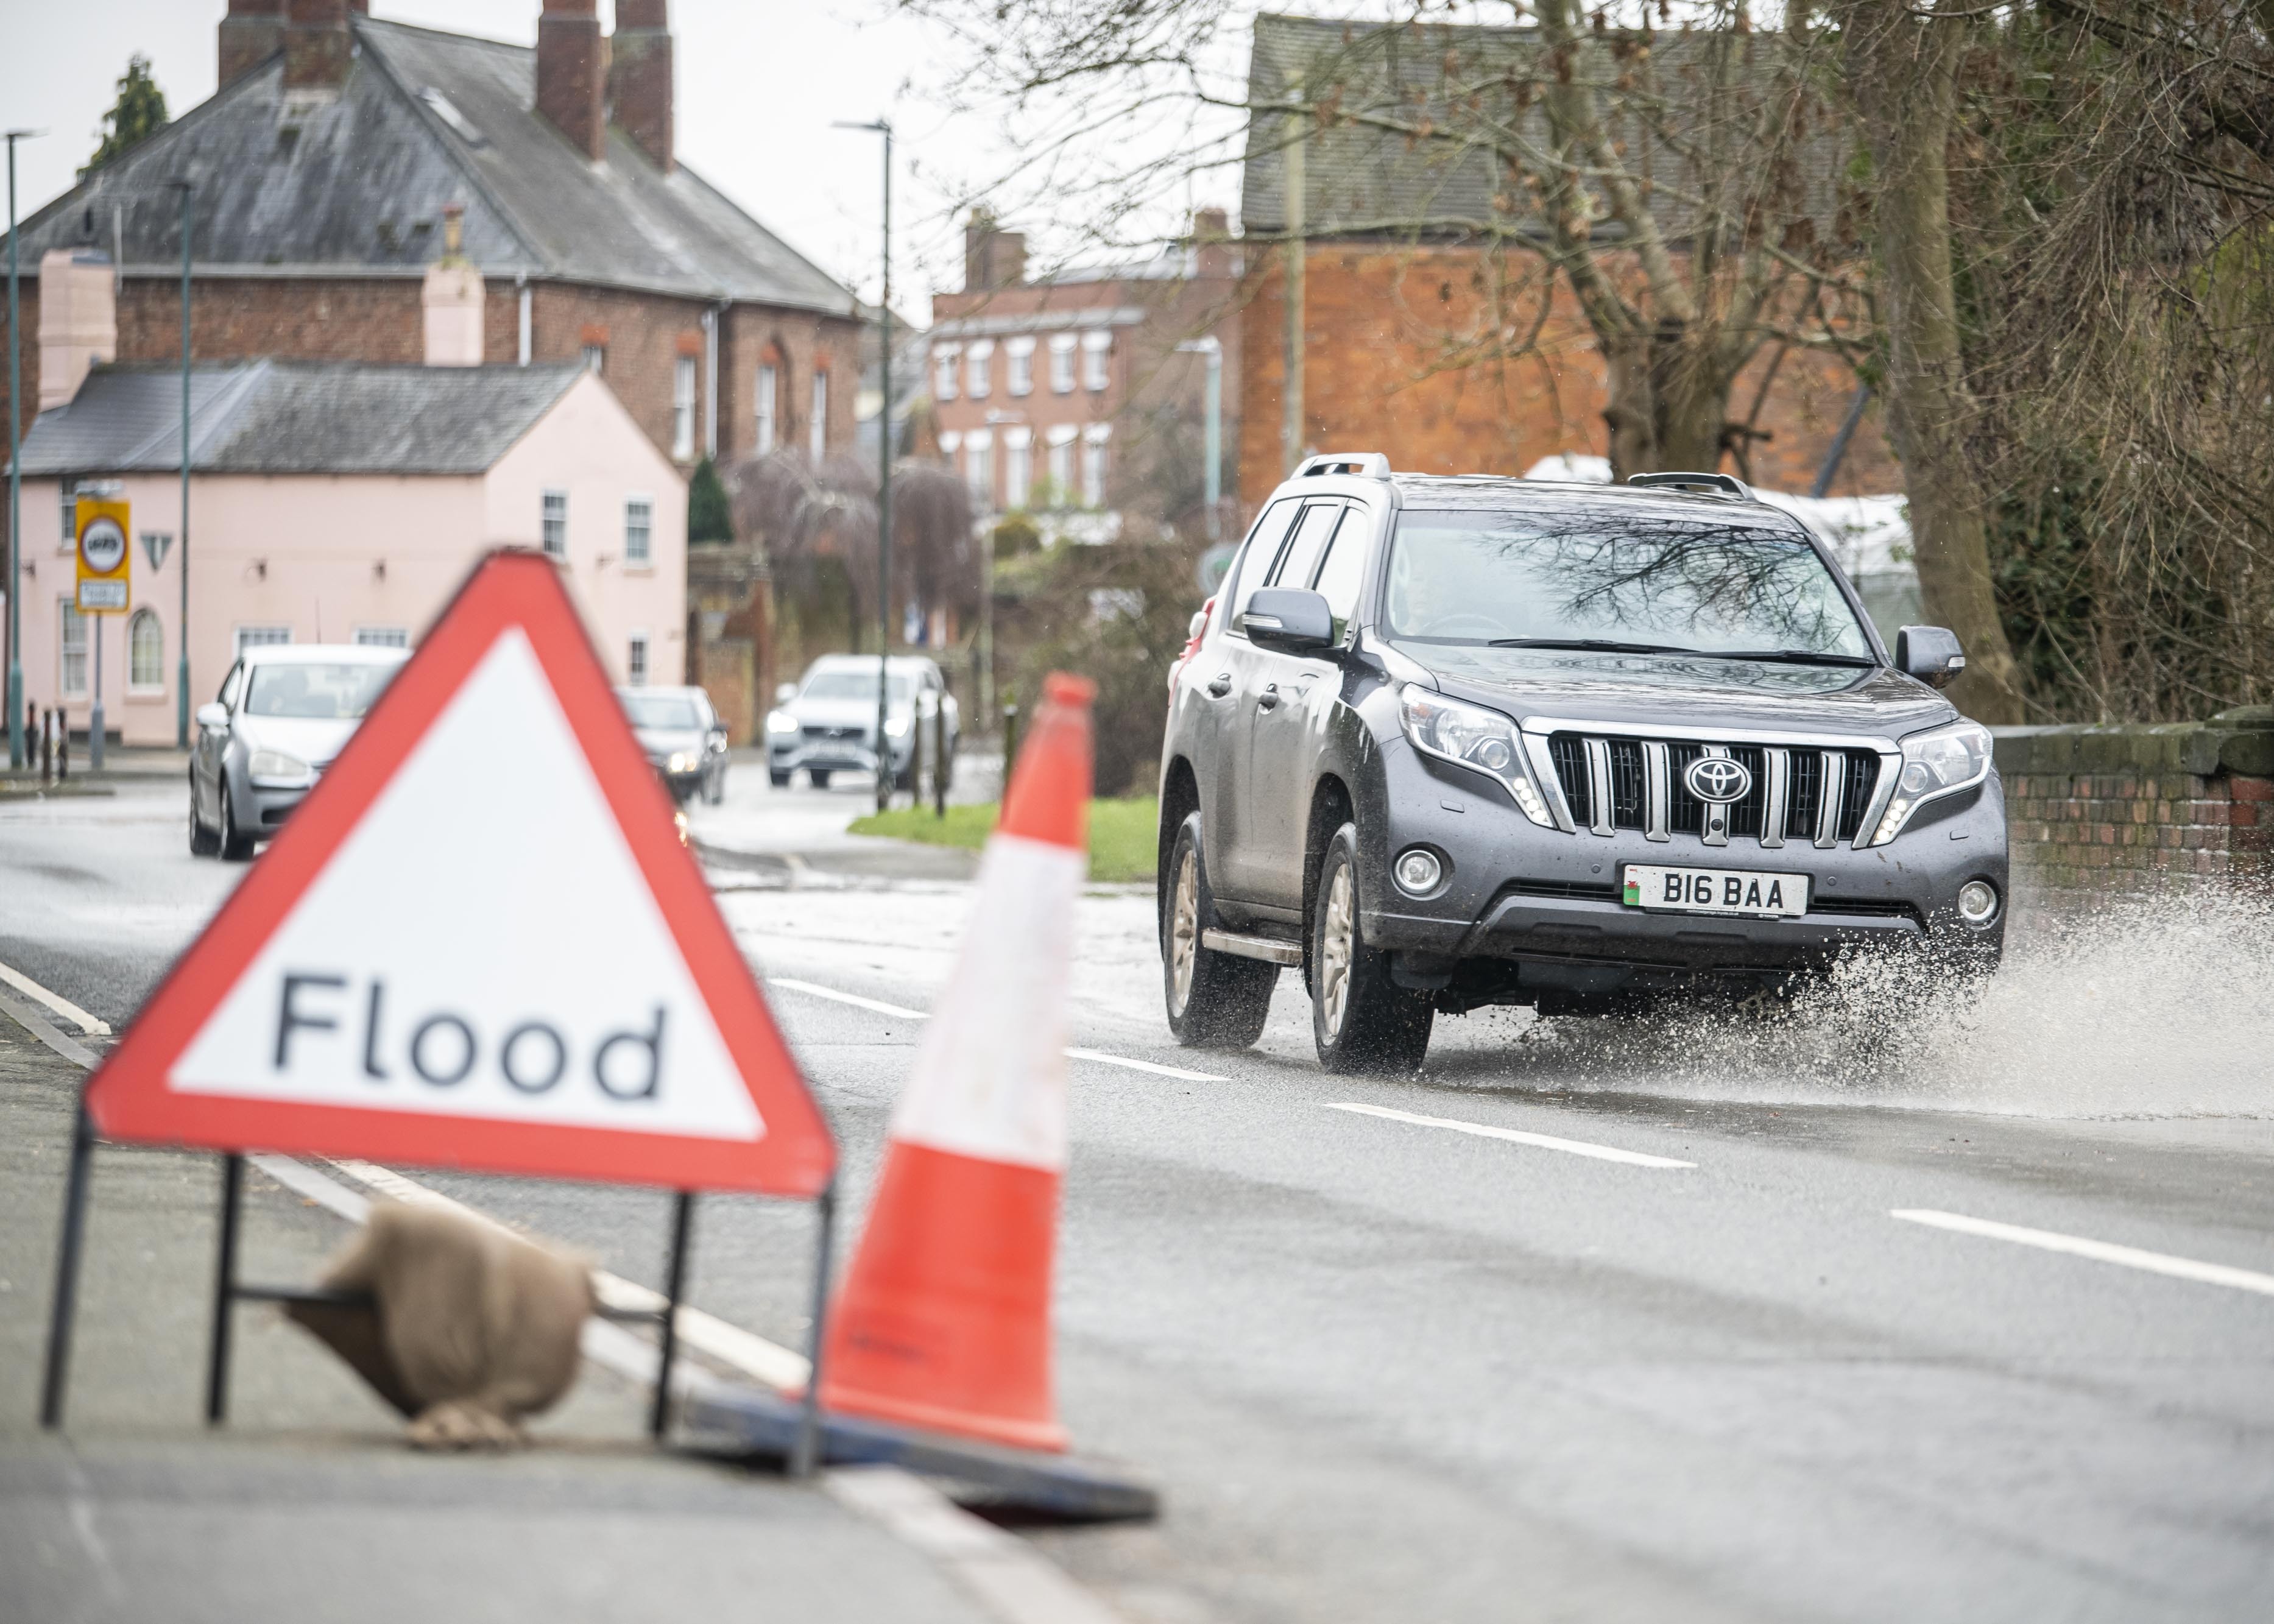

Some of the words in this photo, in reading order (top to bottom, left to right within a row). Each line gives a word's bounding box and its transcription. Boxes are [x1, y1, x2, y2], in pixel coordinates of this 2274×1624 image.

[1664, 873, 1712, 904] B16
[1723, 877, 1784, 908] BAA
[273, 972, 667, 1099] Flood
